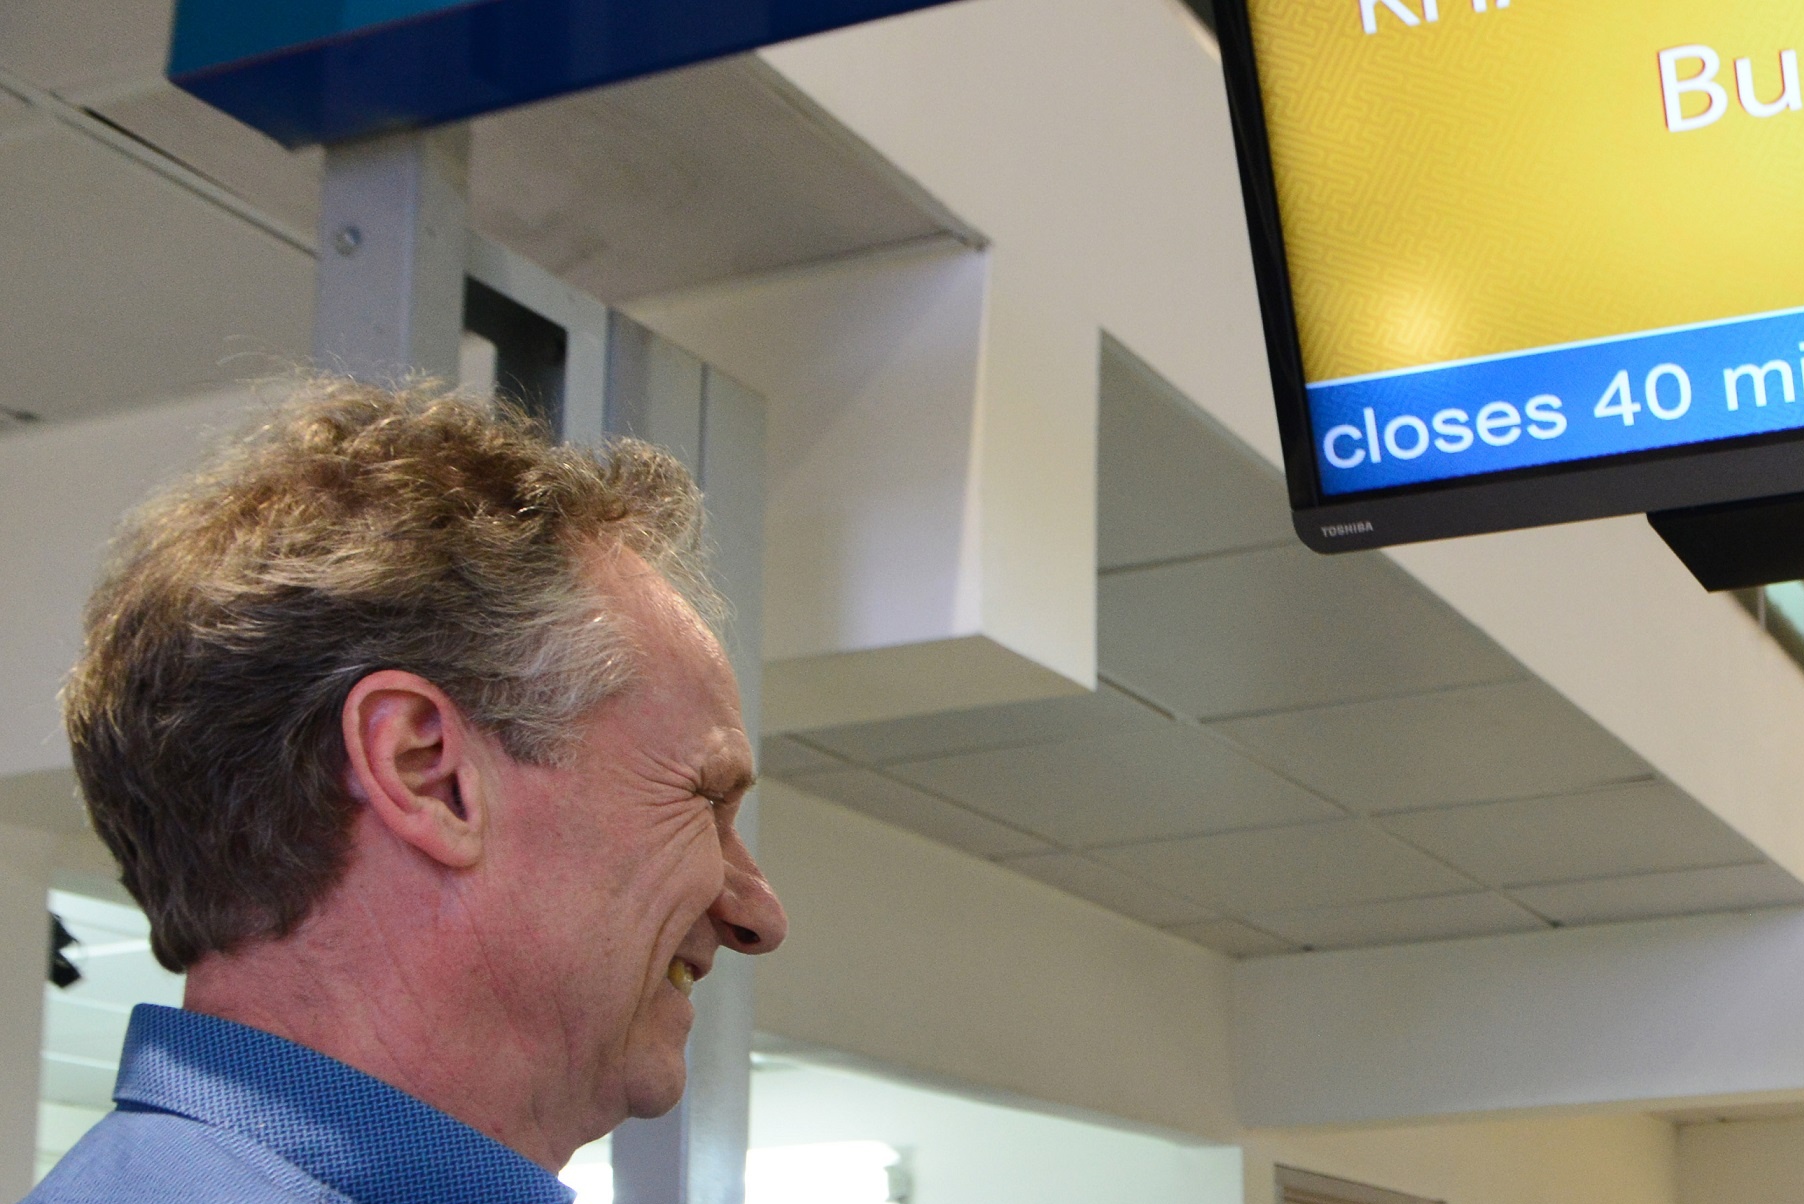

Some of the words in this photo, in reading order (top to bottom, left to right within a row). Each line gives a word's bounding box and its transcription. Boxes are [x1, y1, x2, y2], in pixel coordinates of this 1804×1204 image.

[1323, 408, 1568, 470] closes
[1593, 362, 1693, 427] 40
[1321, 521, 1374, 538] TOSHIBA
